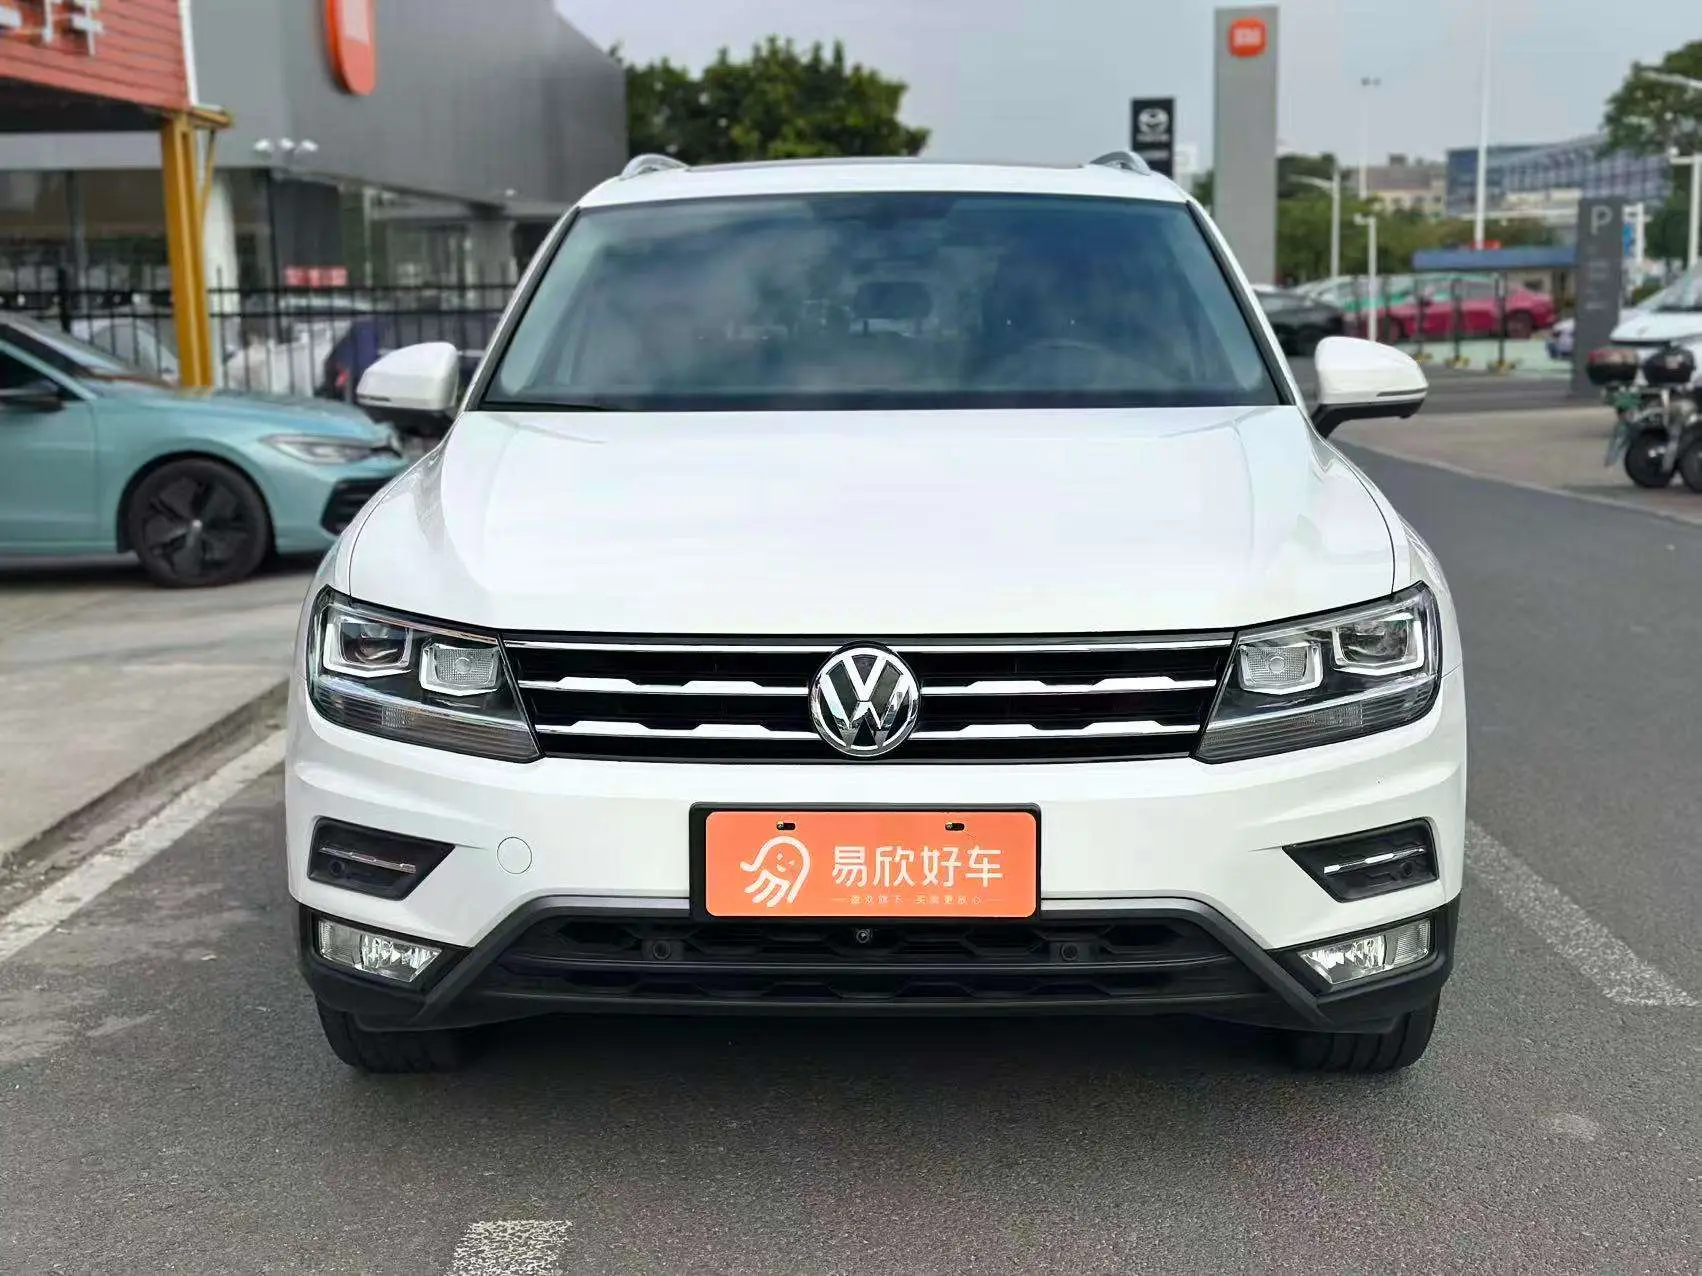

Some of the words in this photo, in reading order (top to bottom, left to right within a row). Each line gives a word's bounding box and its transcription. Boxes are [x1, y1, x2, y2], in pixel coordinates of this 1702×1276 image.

[1590, 205, 1613, 236] P
[812, 648, 918, 755] VW
[832, 845, 1003, 888] 易欣好车
